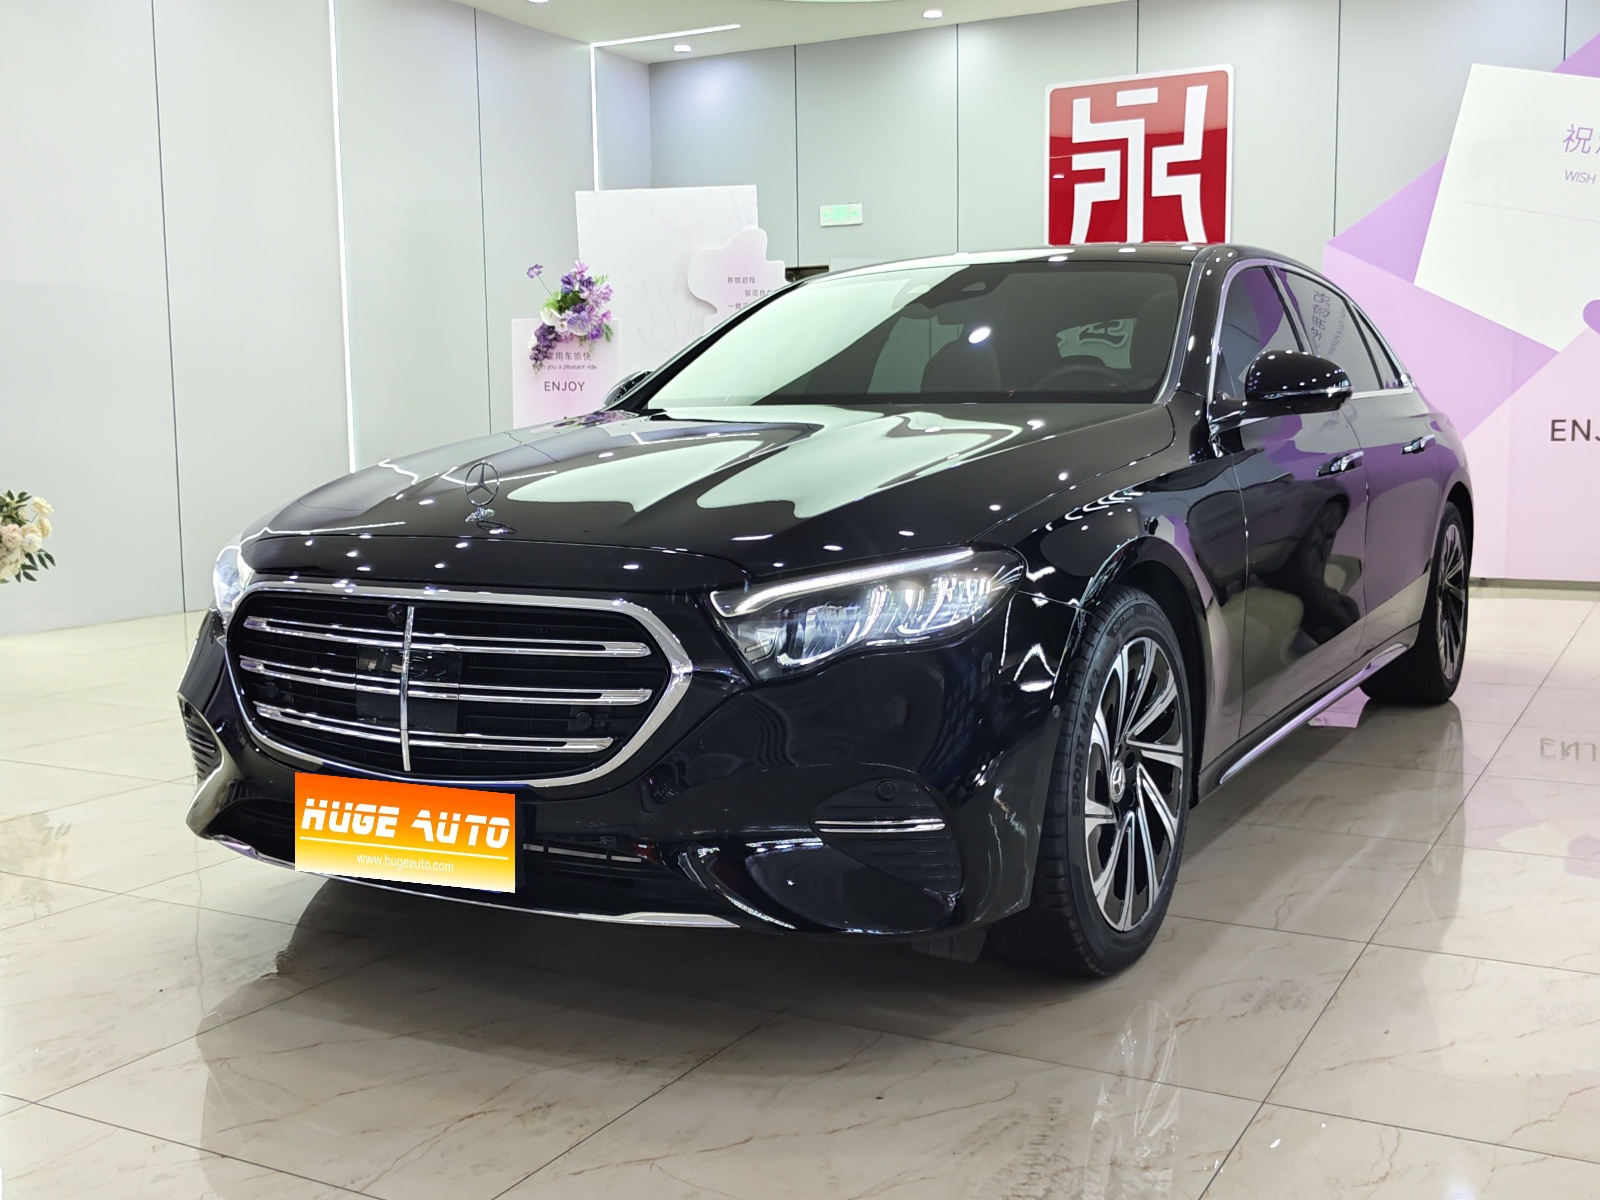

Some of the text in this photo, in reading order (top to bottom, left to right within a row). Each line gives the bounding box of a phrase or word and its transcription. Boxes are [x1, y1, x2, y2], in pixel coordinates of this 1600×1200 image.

[1563, 124, 1600, 154] 祝
[1565, 169, 1597, 184] WISH
[544, 381, 586, 392] ENJOY
[1071, 734, 1085, 817] SPORT
